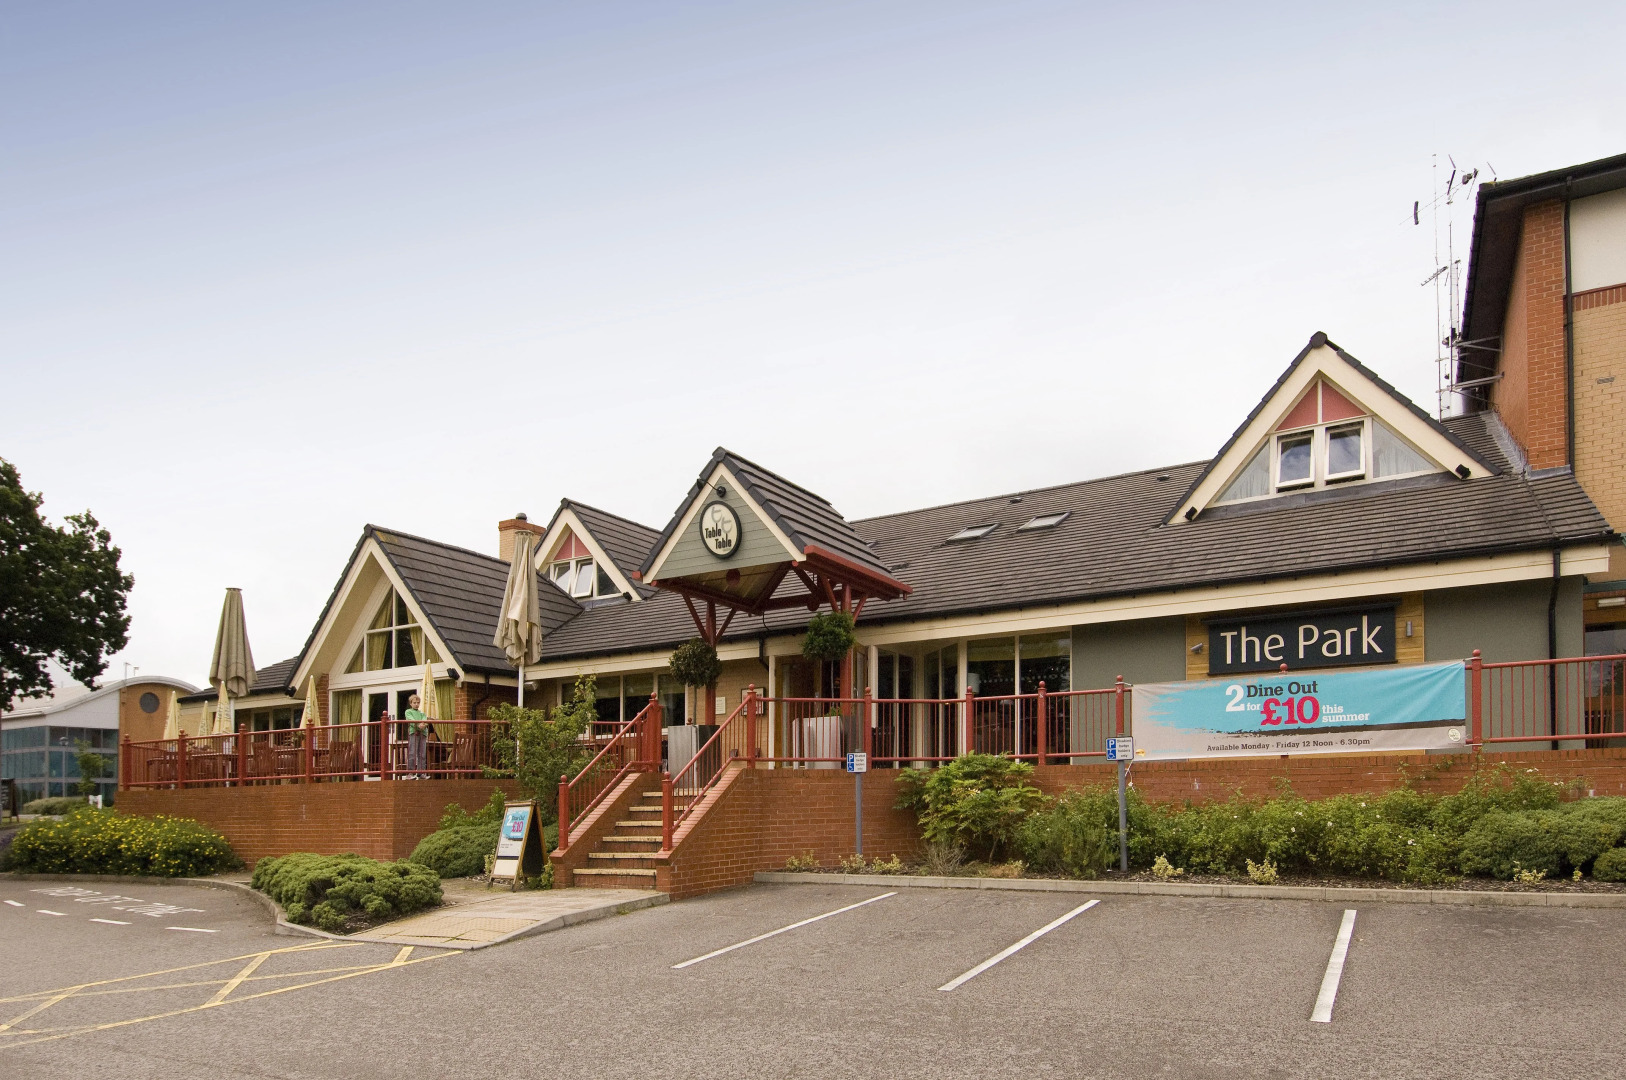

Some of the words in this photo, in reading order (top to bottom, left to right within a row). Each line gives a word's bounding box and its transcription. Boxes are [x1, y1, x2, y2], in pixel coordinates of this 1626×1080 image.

[704, 523, 721, 538] Table
[715, 533, 731, 549] Table
[1219, 625, 1285, 665] The
[1298, 614, 1384, 660] Park
[1246, 684, 1284, 698] Dine
[1287, 680, 1319, 696] Out
[1225, 684, 1245, 713] 2
[1246, 701, 1261, 711] for
[1260, 695, 1320, 726] £10
[1322, 704, 1344, 714] this
[1322, 711, 1370, 723] summer
[1109, 740, 1115, 748] P
[1206, 743, 1240, 753] Available
[1240, 741, 1270, 752] Monday
[1276, 740, 1301, 751] Friday
[1302, 739, 1311, 748] 12
[1312, 738, 1333, 748] Noon
